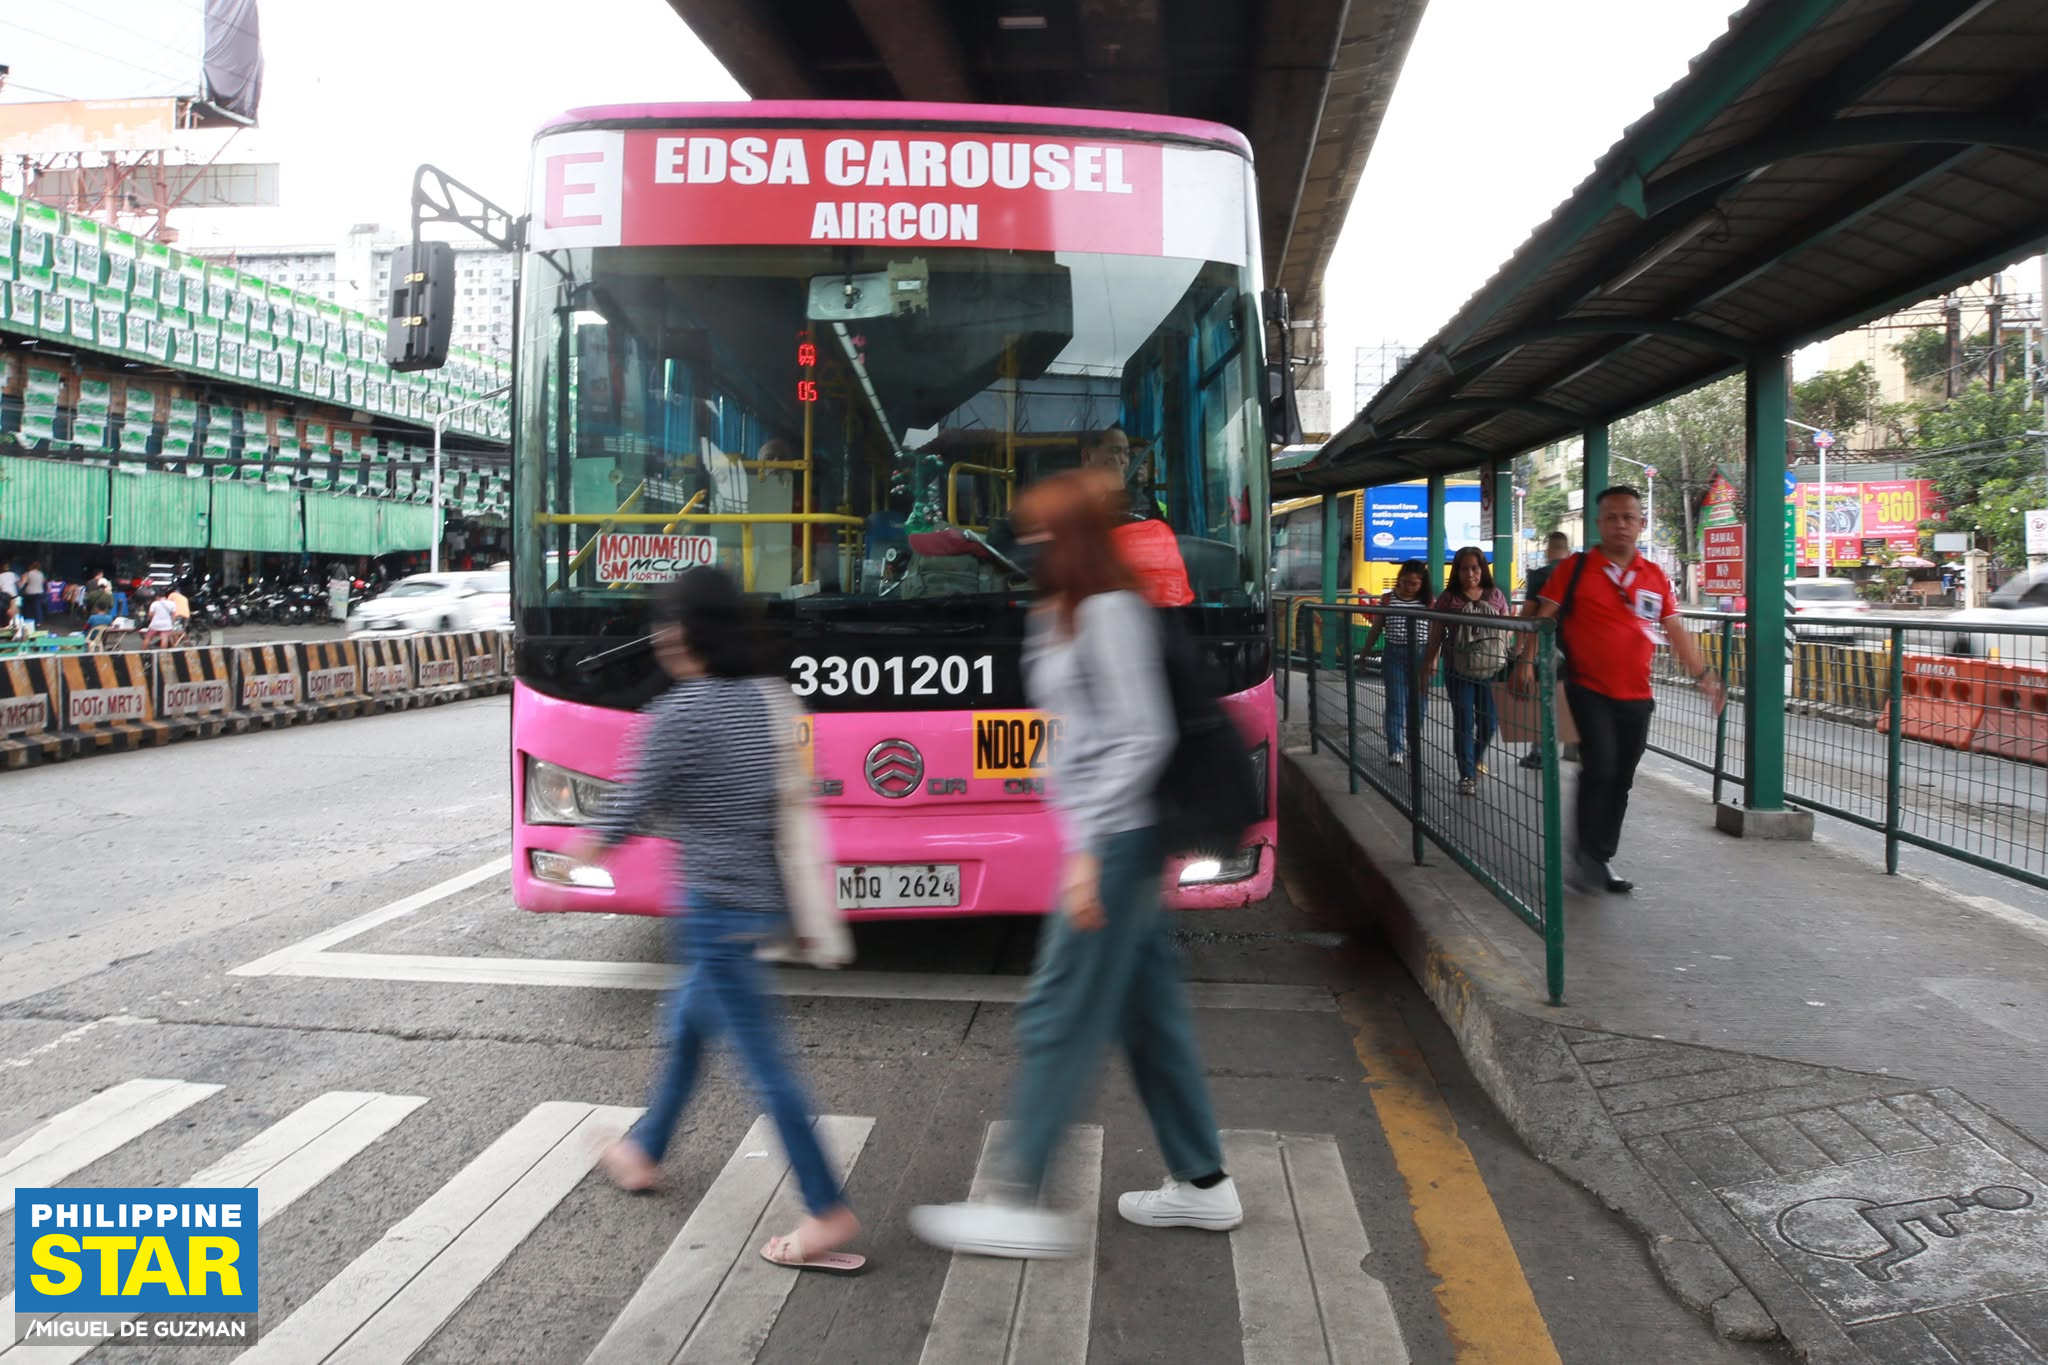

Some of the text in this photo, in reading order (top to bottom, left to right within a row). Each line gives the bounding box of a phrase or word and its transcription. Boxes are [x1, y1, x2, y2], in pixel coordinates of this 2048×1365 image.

[655, 136, 1132, 194] EDSA CAROUSEL
[543, 151, 605, 230] E
[810, 202, 978, 241] AIRCON
[1877, 491, 1915, 523] 360
[1710, 532, 1735, 543] BAWAL
[1707, 546, 1740, 557] TUMAWID
[600, 560, 629, 580] SM
[629, 558, 694, 572] MCU
[1716, 563, 1729, 577] NO
[1707, 579, 1741, 589] JAYWALKING
[791, 655, 993, 696] 3301201
[1915, 663, 1956, 676] MMDA
[244, 681, 268, 698] DOTr
[2020, 675, 2048, 688] MM
[72, 696, 103, 717] DOTr
[167, 690, 193, 708] DOTr
[977, 718, 1064, 769] NDQ26
[840, 875, 954, 899] NDQ 2624
